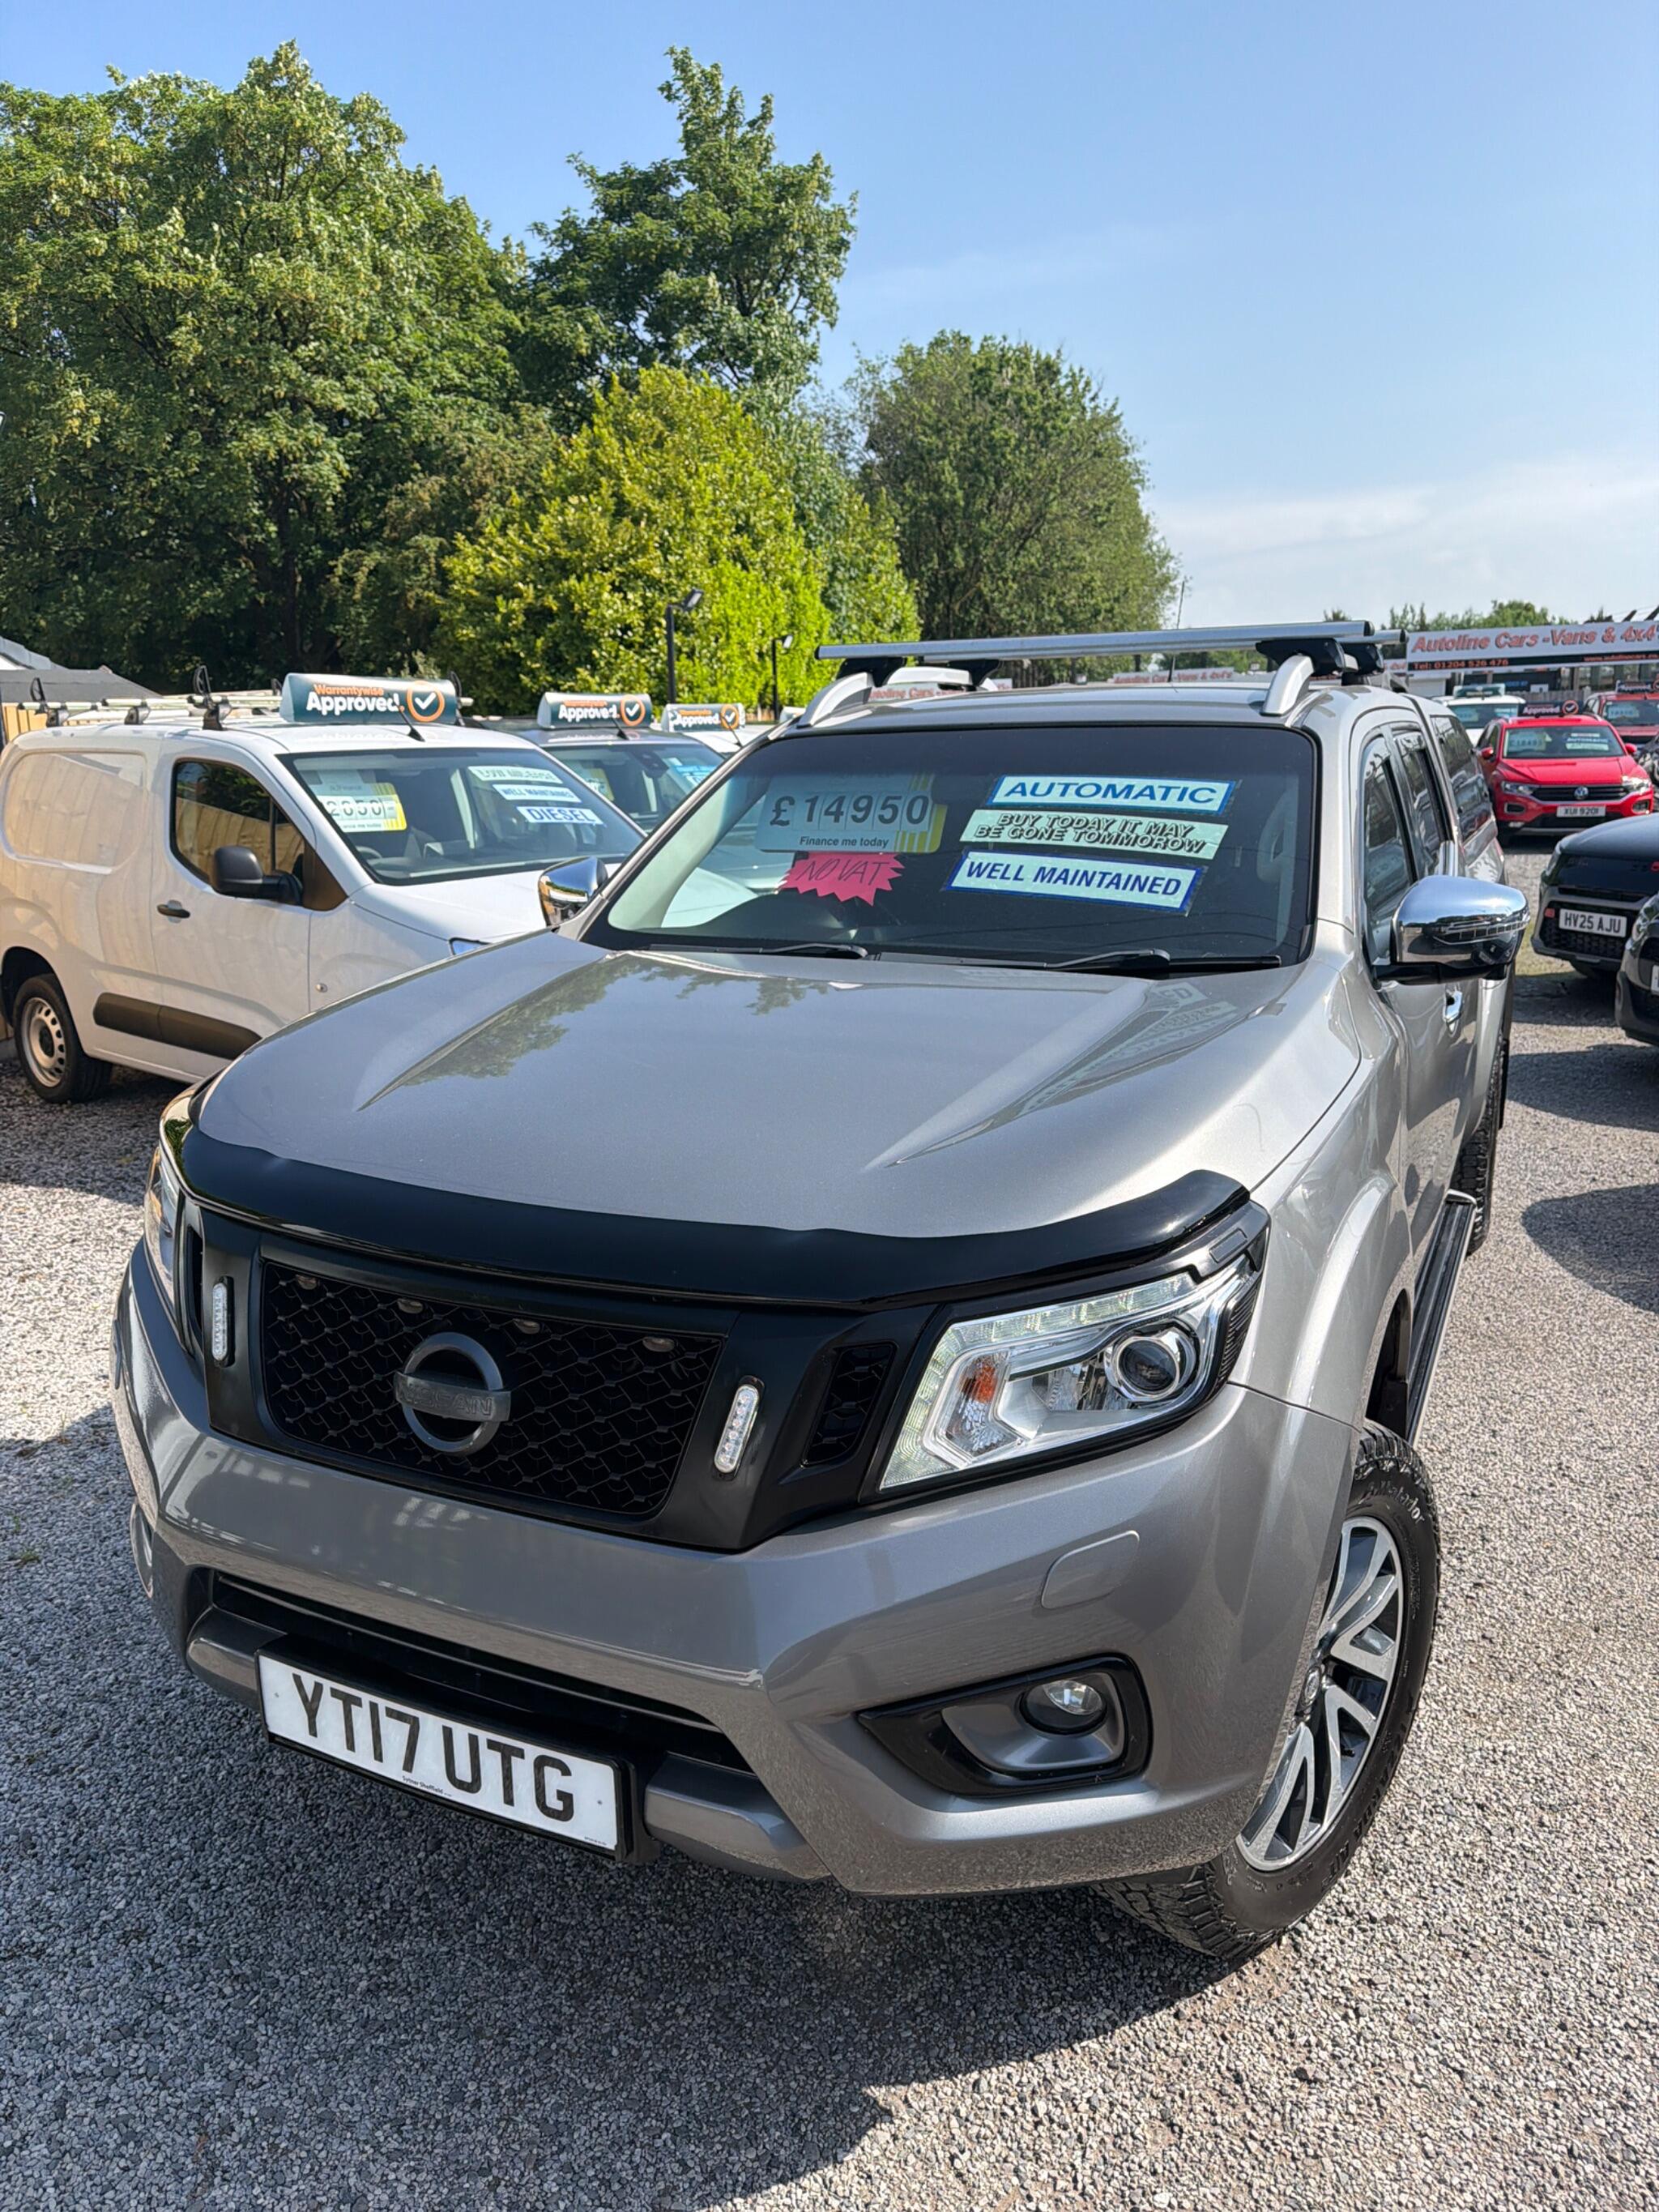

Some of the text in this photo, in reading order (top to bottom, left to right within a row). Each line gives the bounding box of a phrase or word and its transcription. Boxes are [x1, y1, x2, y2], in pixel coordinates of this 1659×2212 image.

[1411, 634, 1490, 653] Autoline
[1495, 630, 1537, 649] Cars
[1601, 625, 1617, 643] &
[313, 684, 384, 696] Warrantywise
[1004, 781, 1217, 804] AUTOMATIC
[528, 809, 597, 822] DIESEL
[769, 794, 929, 826] £14950
[997, 813, 1194, 838] BUY TODAY IT MAY
[800, 836, 889, 848] Finance me today
[975, 825, 1207, 854] BE GONE TOMMOROW
[796, 857, 890, 886] NO VAT
[966, 860, 1181, 896] WELL MAINTAINED
[1564, 912, 1622, 933] HV25 AJU
[292, 1672, 574, 1822] YT17 UTG
